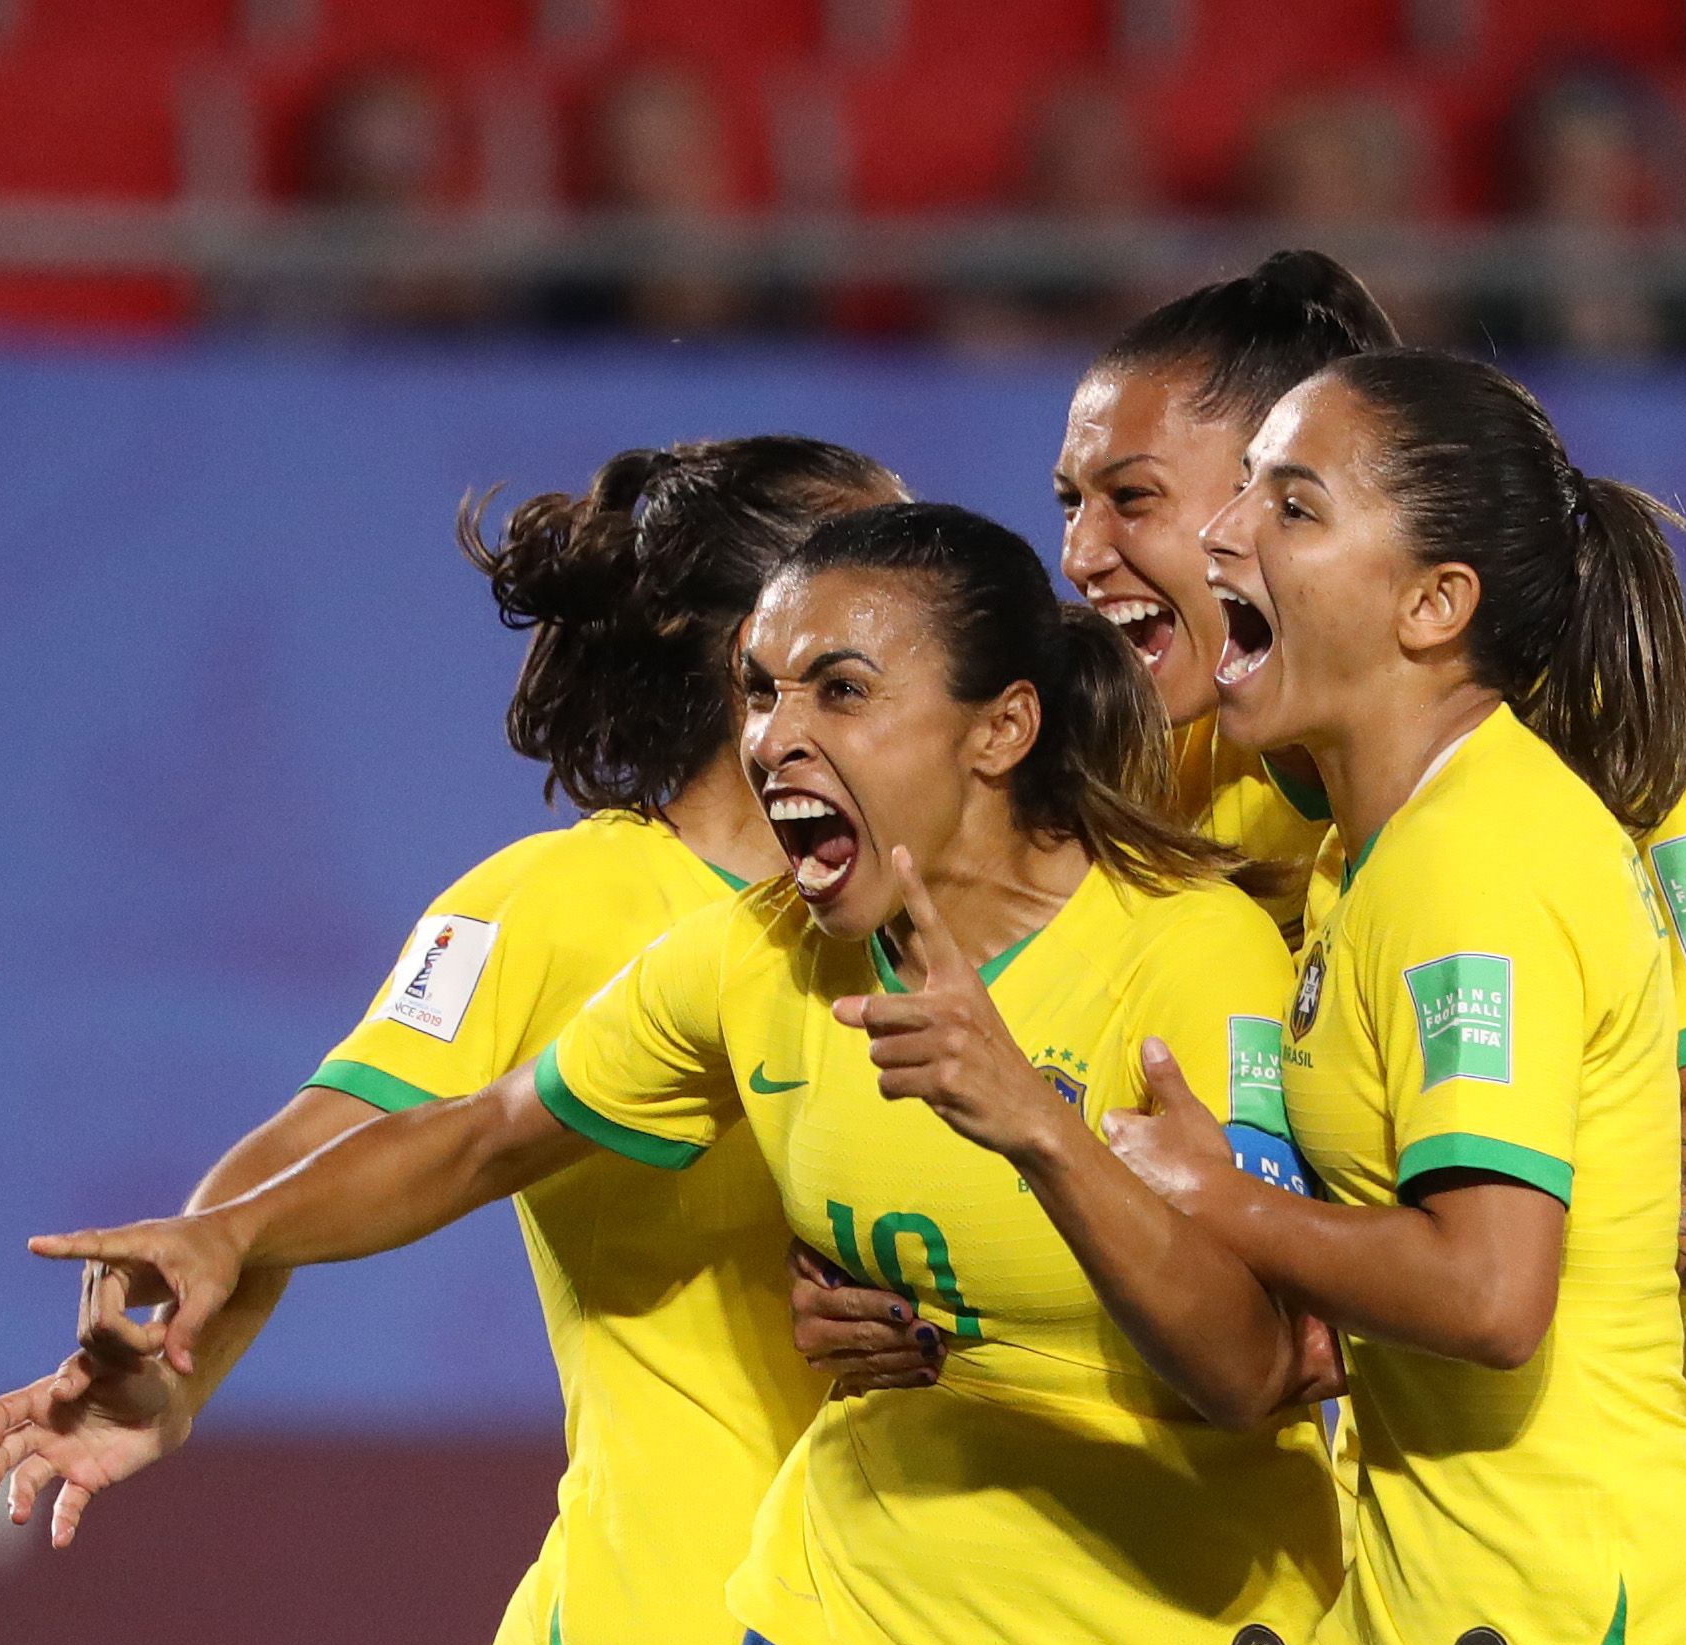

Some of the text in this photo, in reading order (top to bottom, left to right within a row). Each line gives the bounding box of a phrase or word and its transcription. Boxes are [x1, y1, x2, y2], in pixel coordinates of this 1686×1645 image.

[1422, 987, 1502, 1015] LIVING
[1425, 1001, 1502, 1030] FOOTBALL
[1461, 1027, 1502, 1048] FIFA
